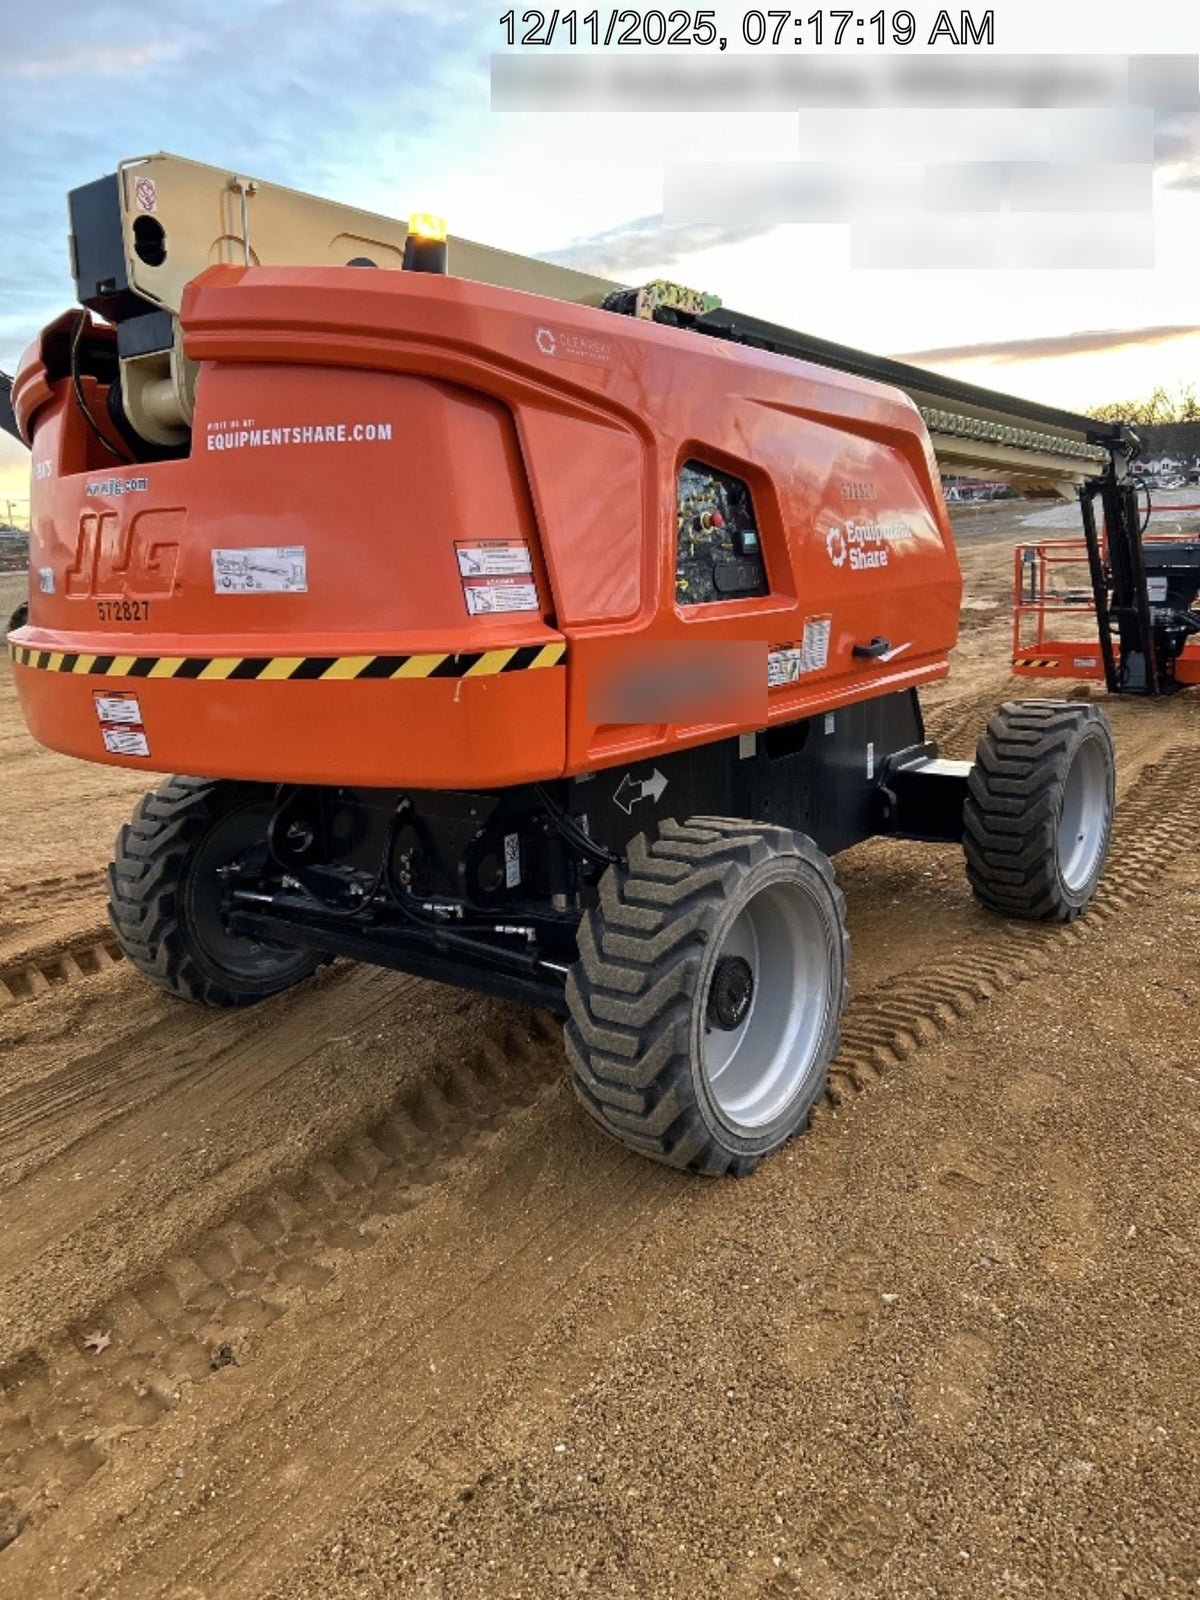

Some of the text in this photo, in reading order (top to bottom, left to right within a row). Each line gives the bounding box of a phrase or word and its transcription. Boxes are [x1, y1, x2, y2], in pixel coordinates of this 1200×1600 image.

[206, 423, 393, 451] EQUIPMENTSHARE.COM
[845, 520, 913, 547] Equipment
[65, 506, 187, 600] JLG
[849, 546, 888, 570] Share
[97, 601, 149, 622] 572827
